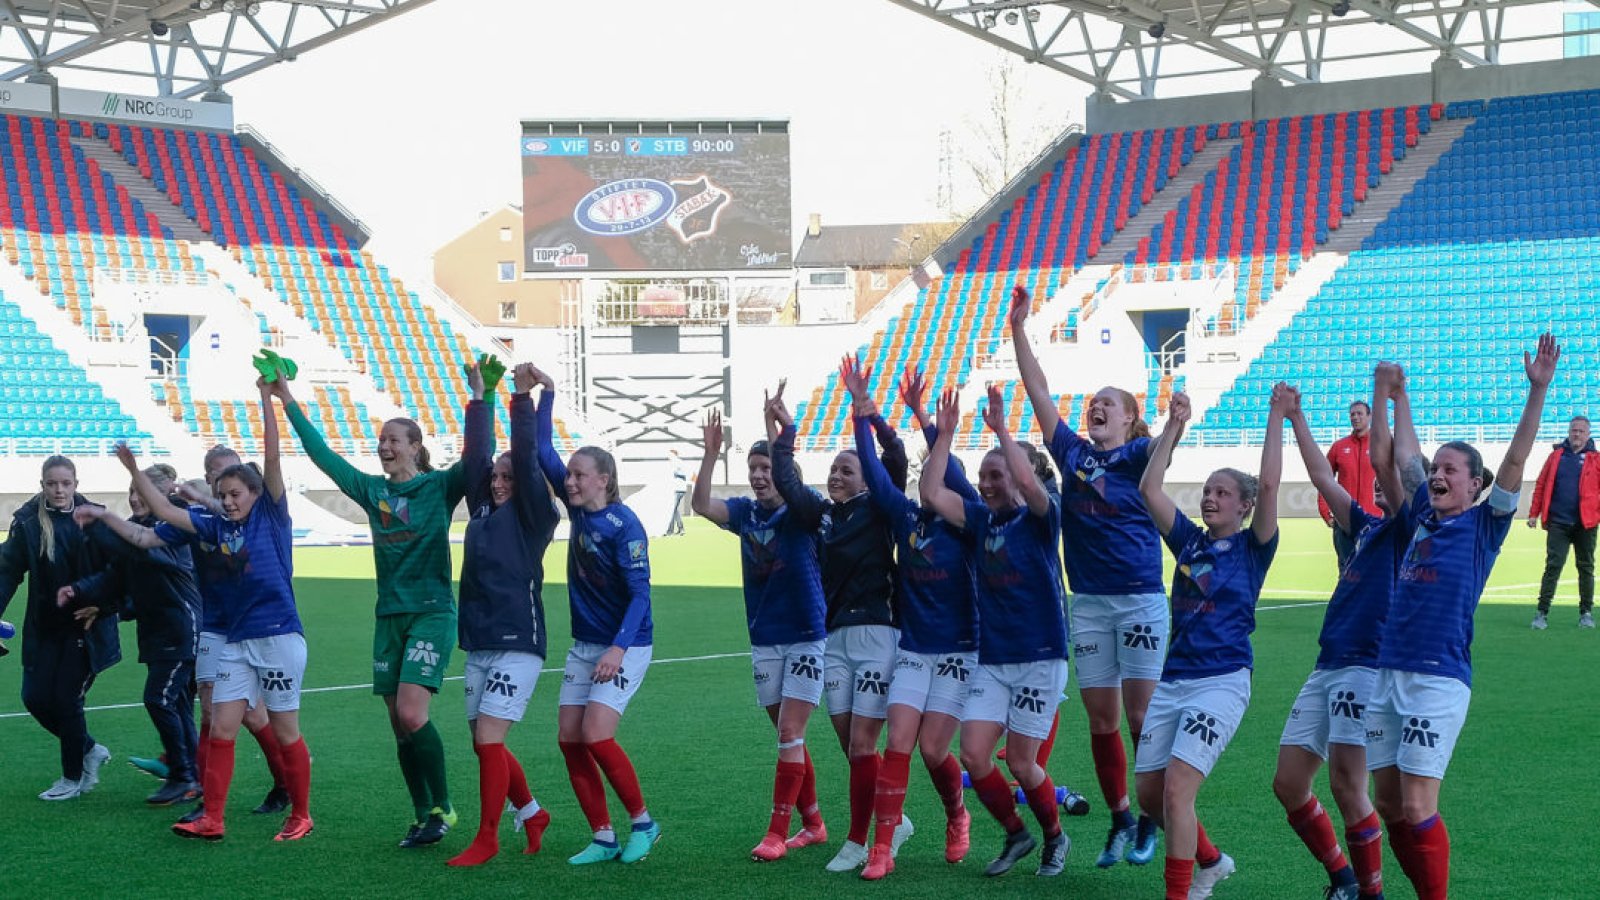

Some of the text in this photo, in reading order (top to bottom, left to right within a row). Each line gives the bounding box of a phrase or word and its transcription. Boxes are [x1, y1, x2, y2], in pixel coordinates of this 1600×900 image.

[561, 140, 586, 153] VIF
[593, 140, 621, 152] 5:0
[653, 140, 686, 153] STB
[692, 140, 734, 152] 90:00
[535, 249, 560, 261] TOPP
